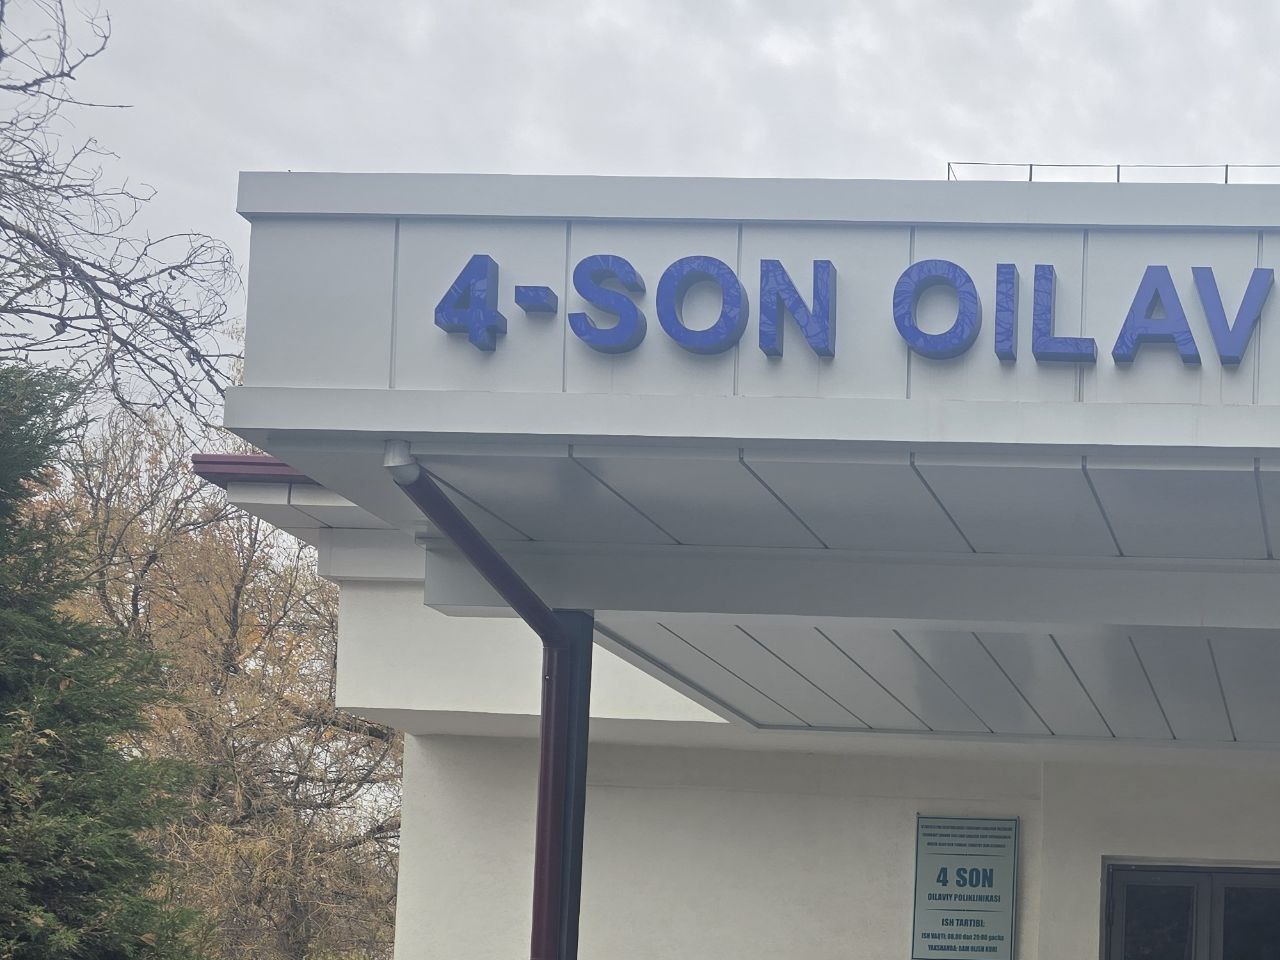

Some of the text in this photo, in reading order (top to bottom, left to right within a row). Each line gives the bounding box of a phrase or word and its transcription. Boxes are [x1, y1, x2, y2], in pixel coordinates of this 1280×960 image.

[433, 253, 836, 361] 4-SON
[936, 867, 994, 888] 4 SON
[927, 893, 1001, 903] OILAVIY POLIKLINIKASI
[941, 918, 954, 927] ISH
